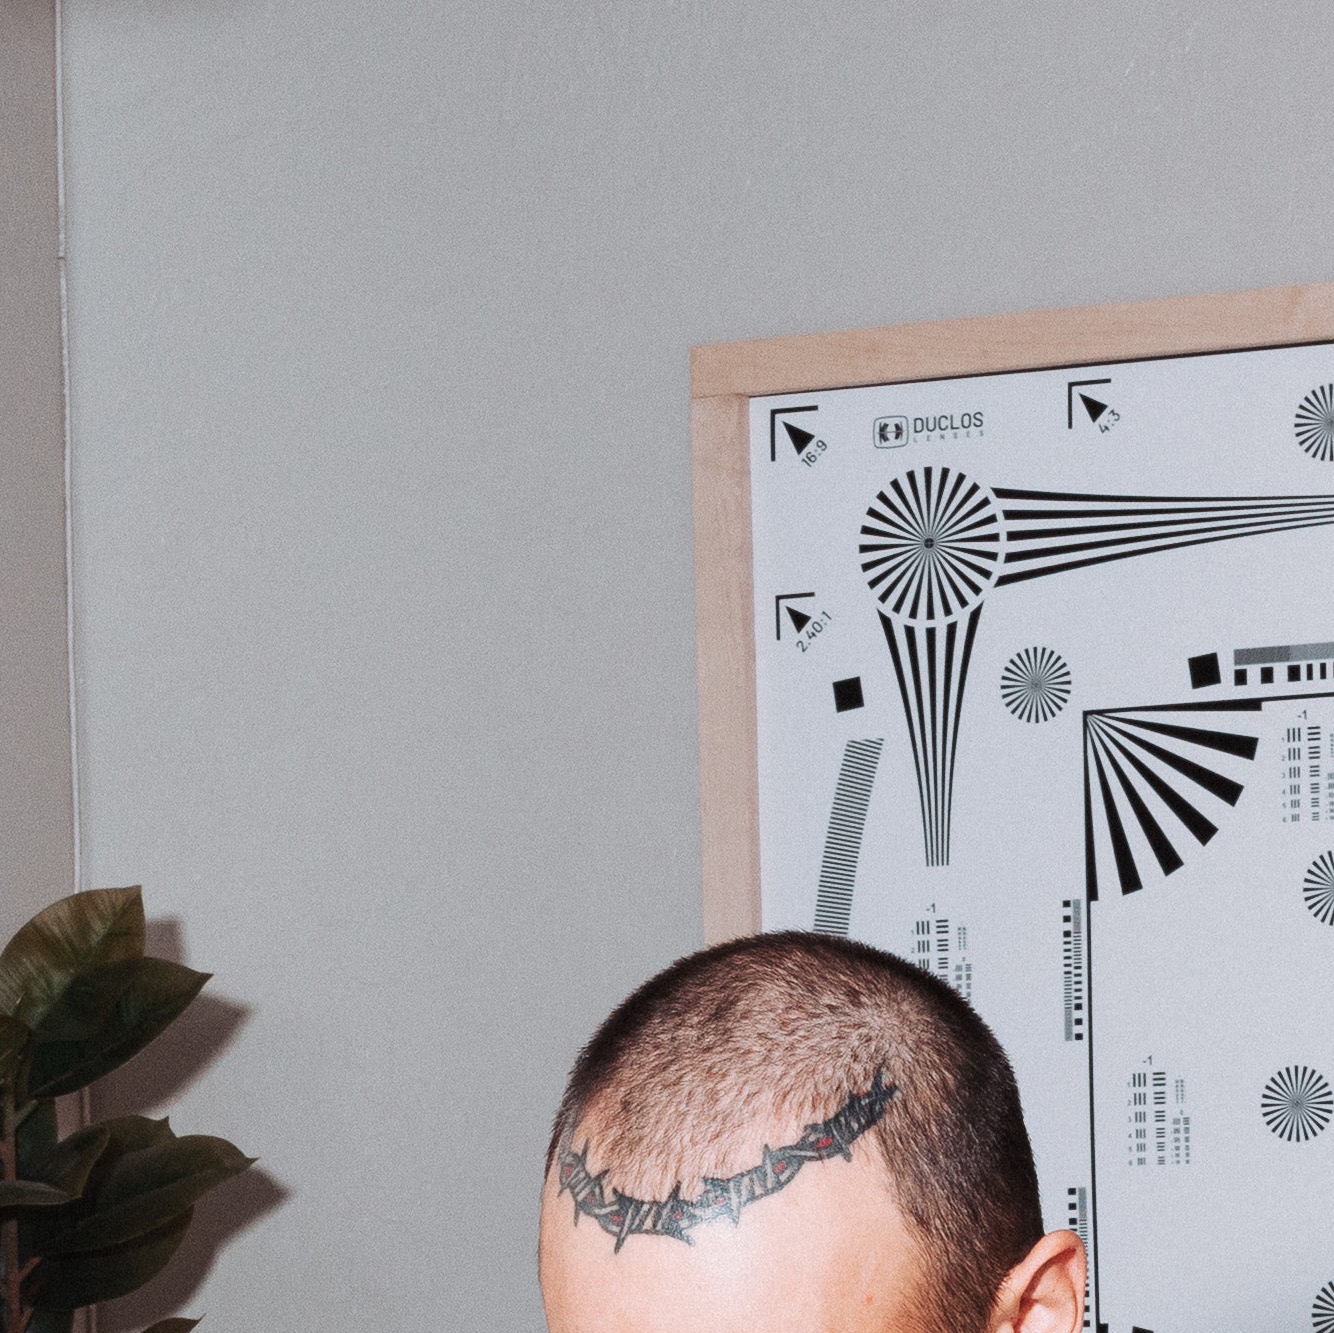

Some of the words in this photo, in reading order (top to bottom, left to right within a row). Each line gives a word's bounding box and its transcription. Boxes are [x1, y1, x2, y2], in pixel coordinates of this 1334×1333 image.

[913, 411, 984, 434] DUCLOS
[1098, 409, 1121, 434] 4:3
[801, 439, 828, 468] 16:9
[796, 610, 832, 653] 2.40:1
